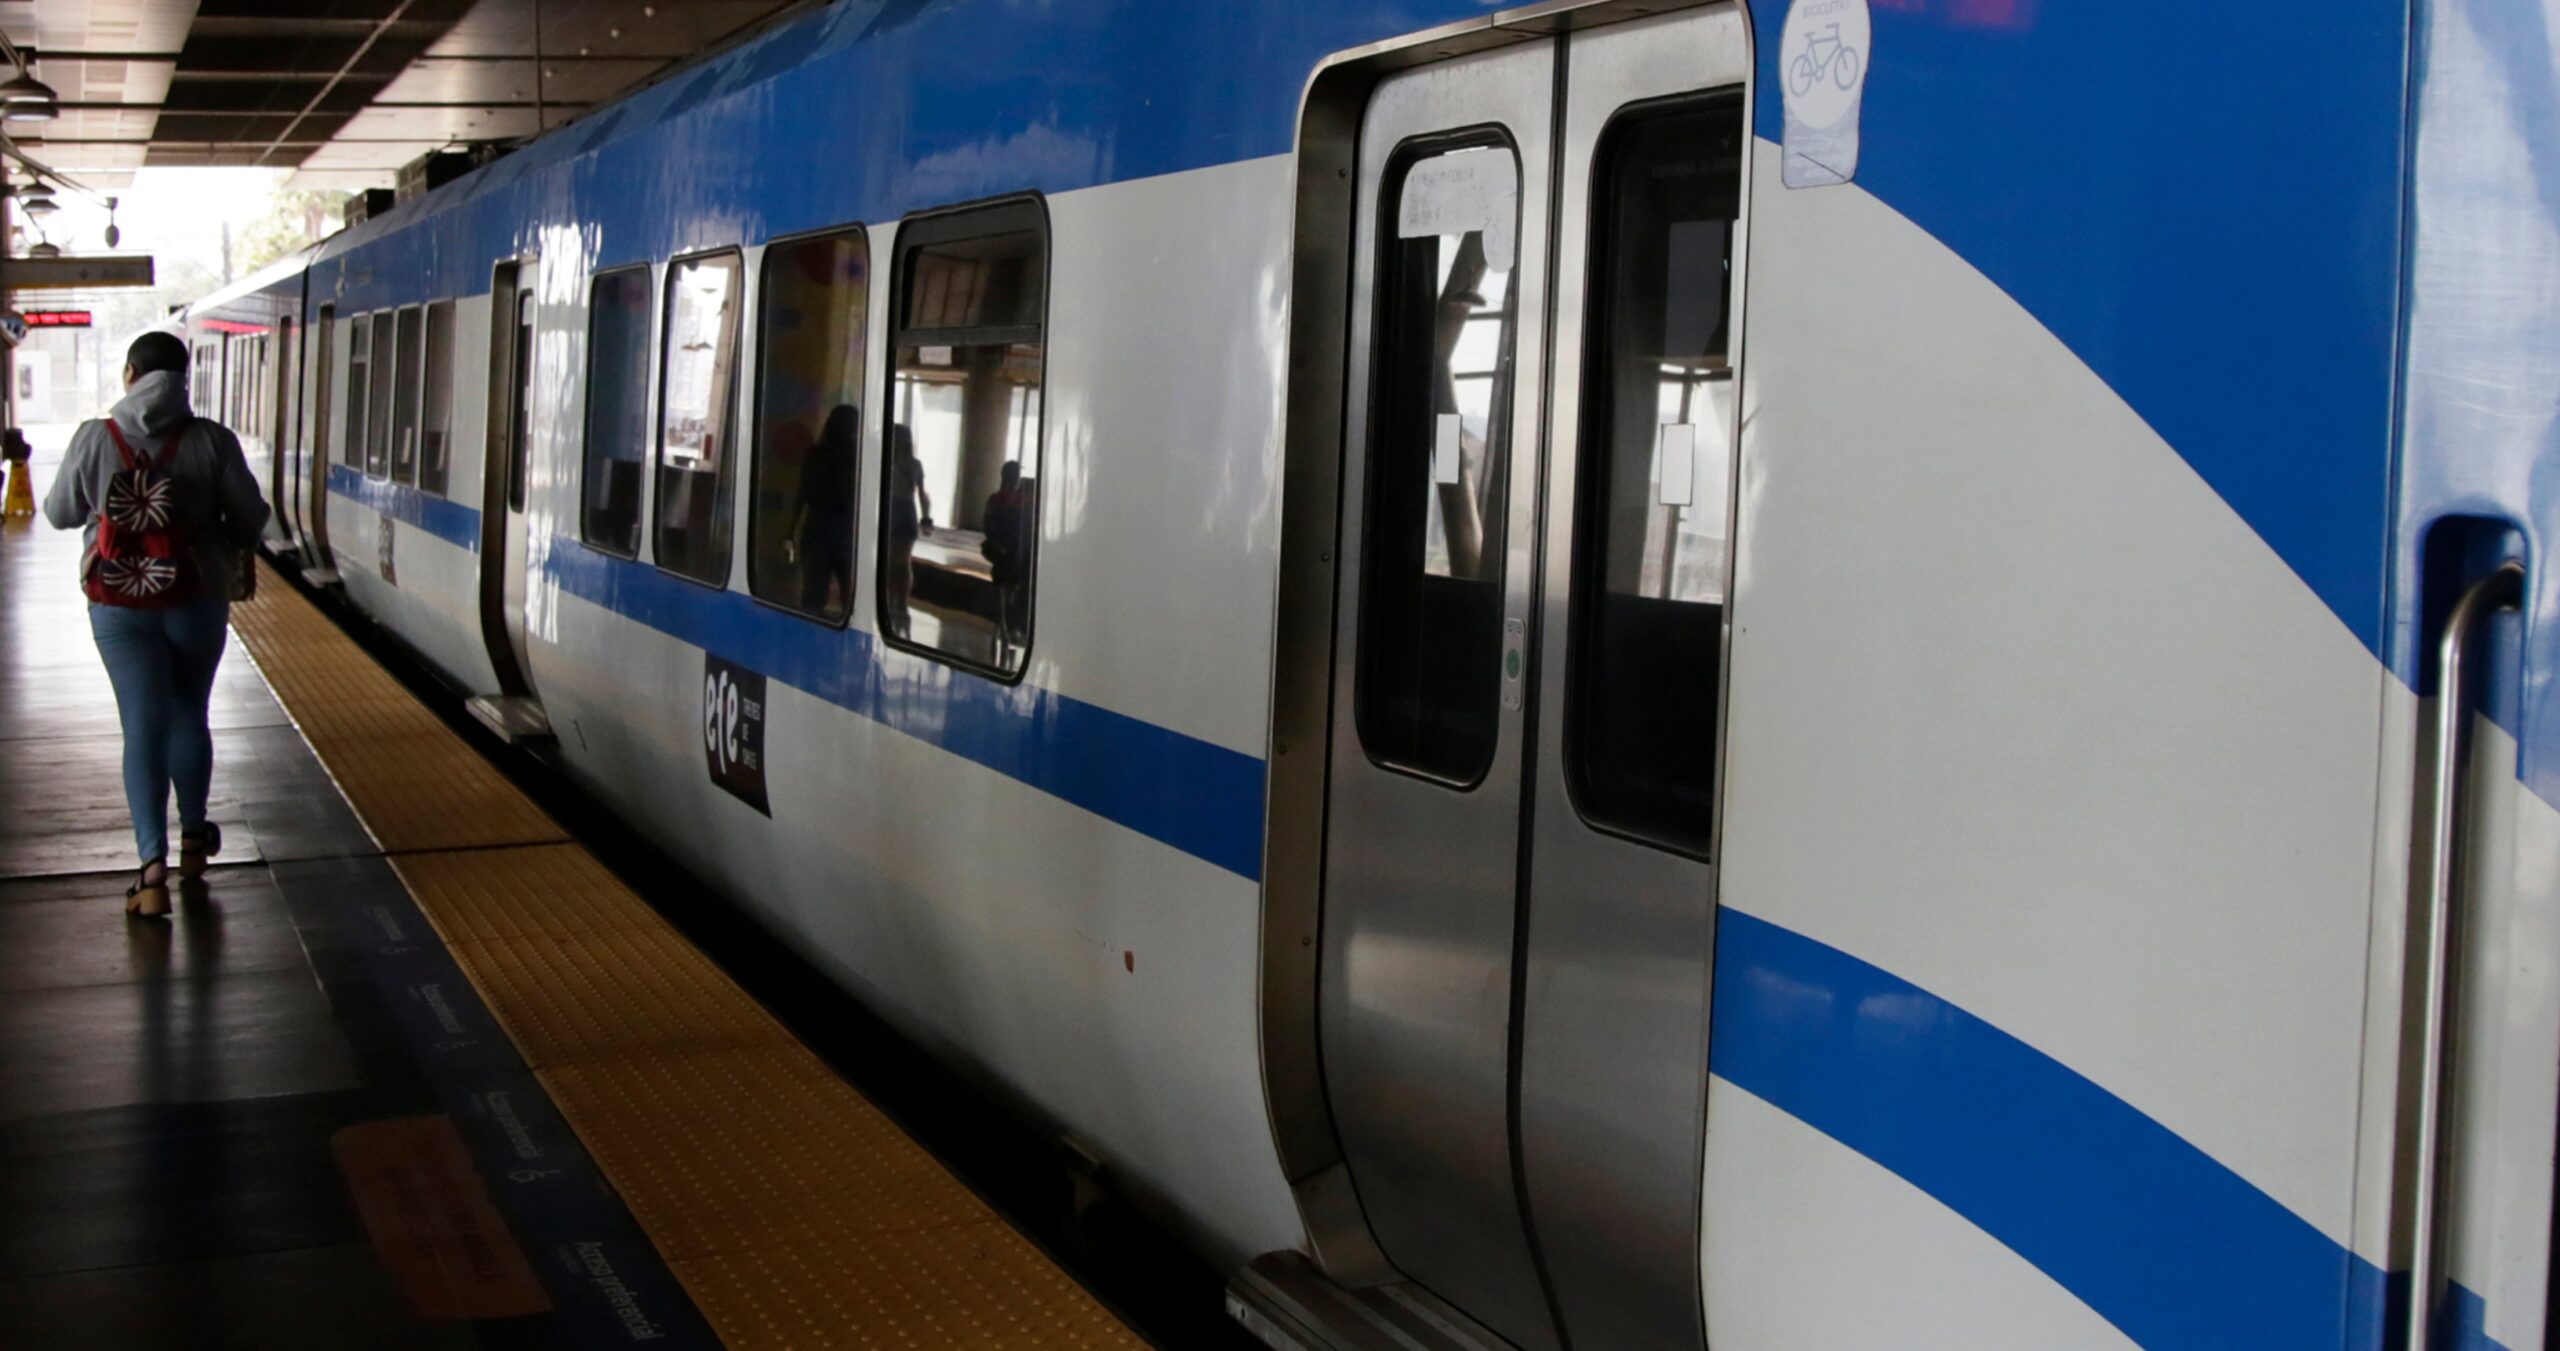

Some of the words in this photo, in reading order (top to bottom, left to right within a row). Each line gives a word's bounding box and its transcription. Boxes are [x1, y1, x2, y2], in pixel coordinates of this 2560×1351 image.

[1802, 1, 1849, 18] BICICLETAS
[705, 670, 738, 775] efe
[574, 1240, 614, 1276] Acceso
[590, 1274, 666, 1341] preferencial
